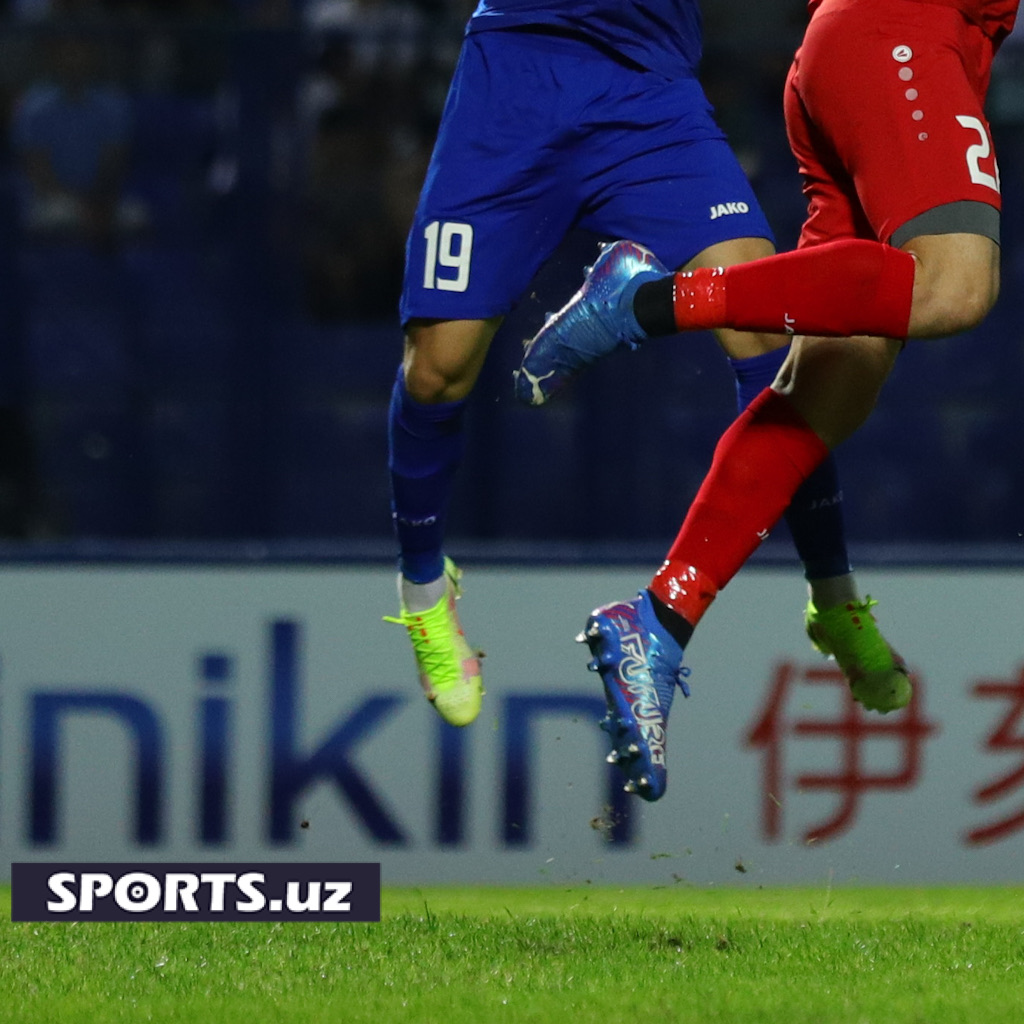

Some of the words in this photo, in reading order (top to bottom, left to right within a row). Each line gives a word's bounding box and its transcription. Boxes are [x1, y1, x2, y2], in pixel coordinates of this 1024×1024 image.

[954, 115, 1001, 195] 2
[710, 202, 749, 220] JAKO
[423, 220, 474, 293] 19
